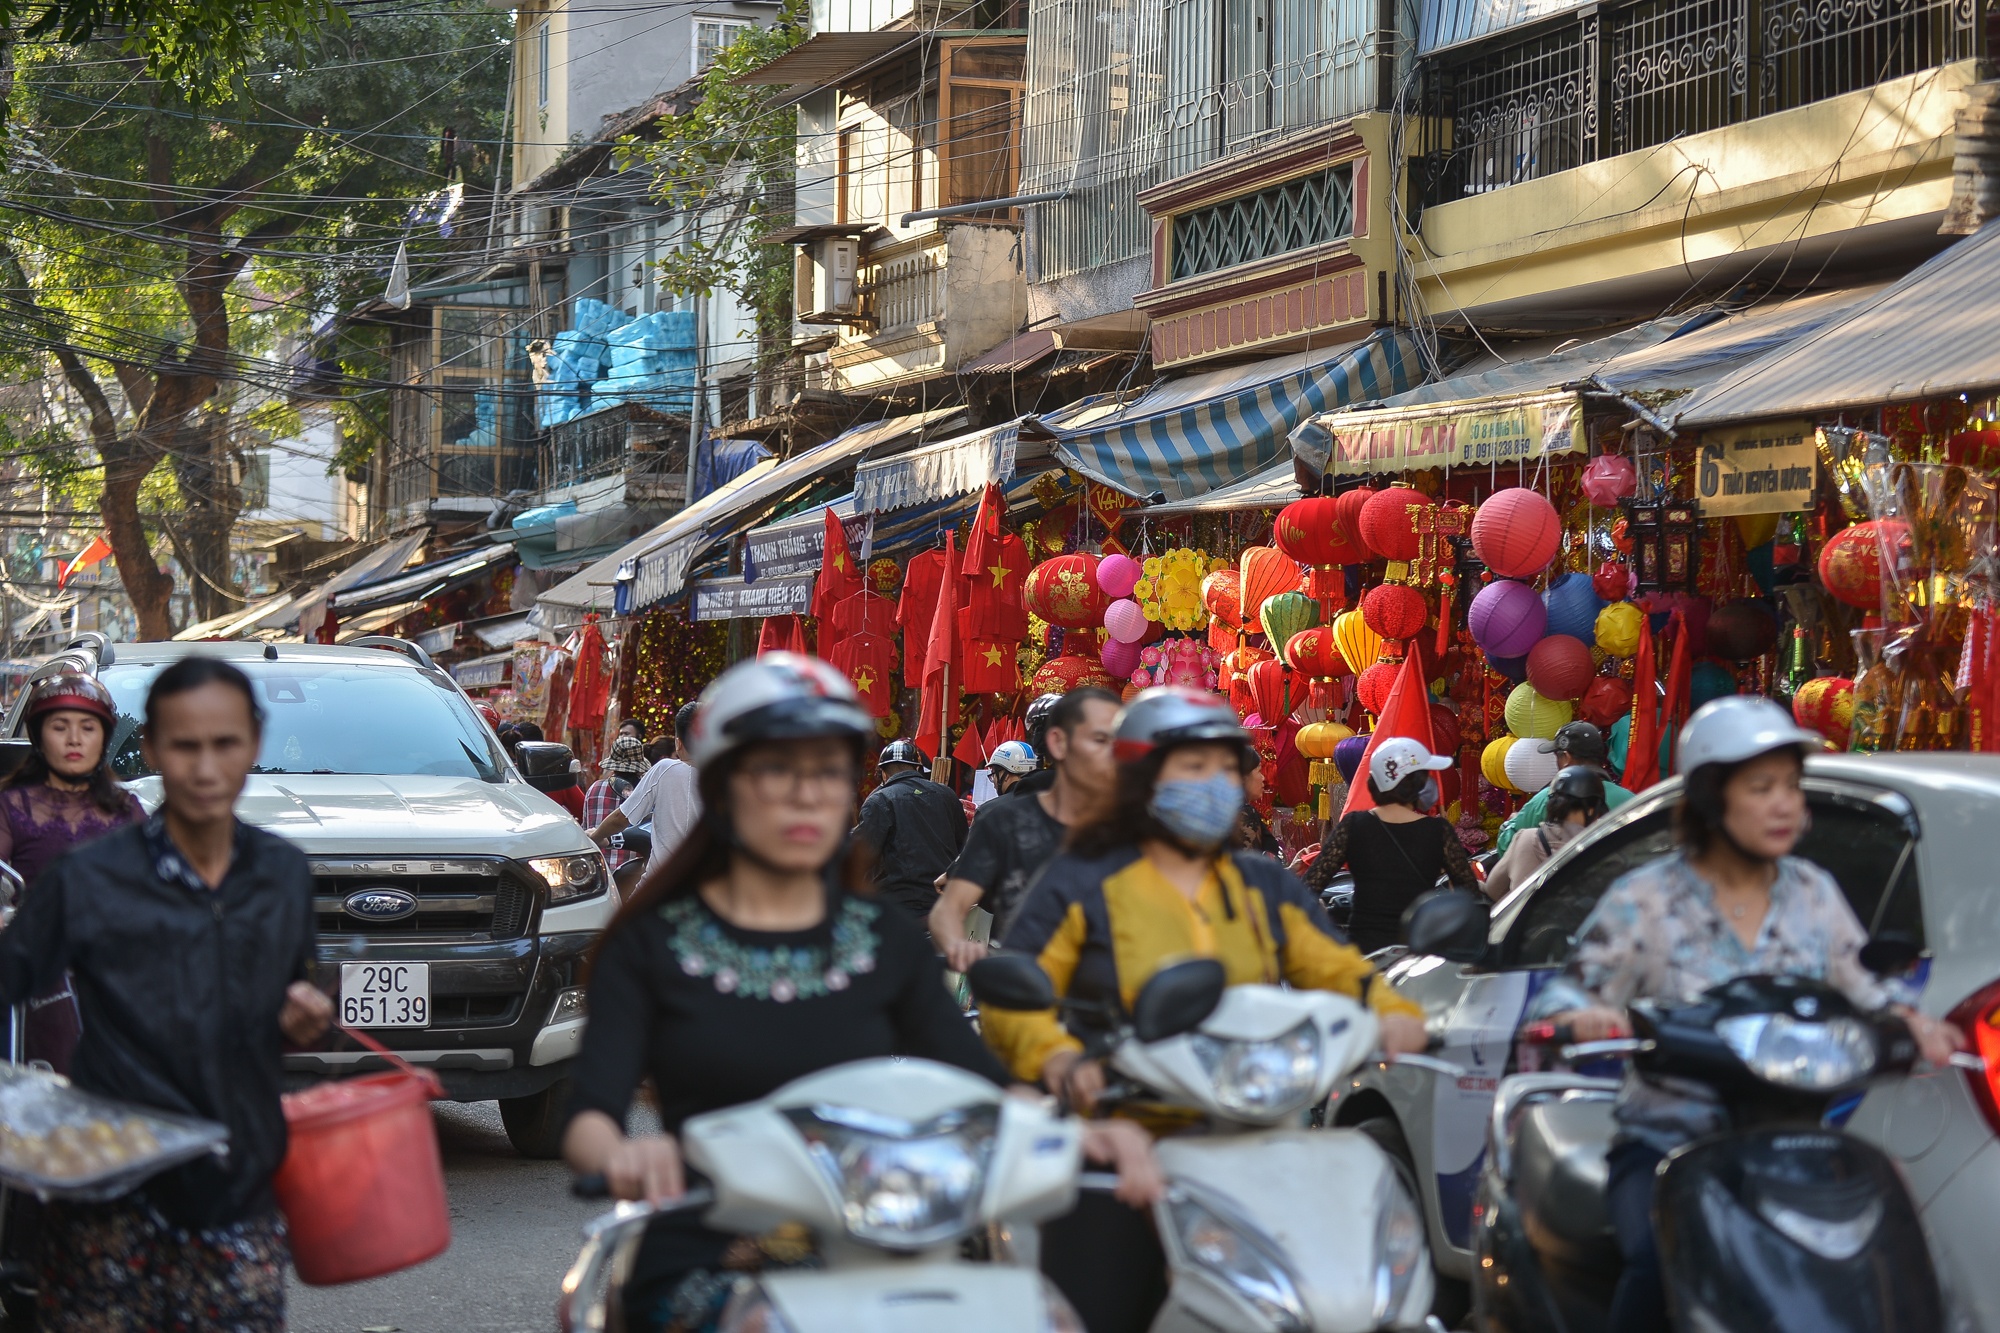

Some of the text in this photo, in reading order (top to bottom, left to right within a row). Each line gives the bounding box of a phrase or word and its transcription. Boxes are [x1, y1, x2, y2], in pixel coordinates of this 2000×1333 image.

[1404, 424, 1457, 457] LAN
[1482, 424, 1488, 439] 8
[1498, 440, 1512, 456] 238
[750, 541, 778, 564] THANH
[739, 588, 768, 607] KHANH
[790, 585, 807, 603] 12B
[312, 862, 486, 874] ANGER
[362, 895, 402, 912] Ford
[362, 966, 408, 993] 29C
[344, 997, 426, 1024] 651.39
